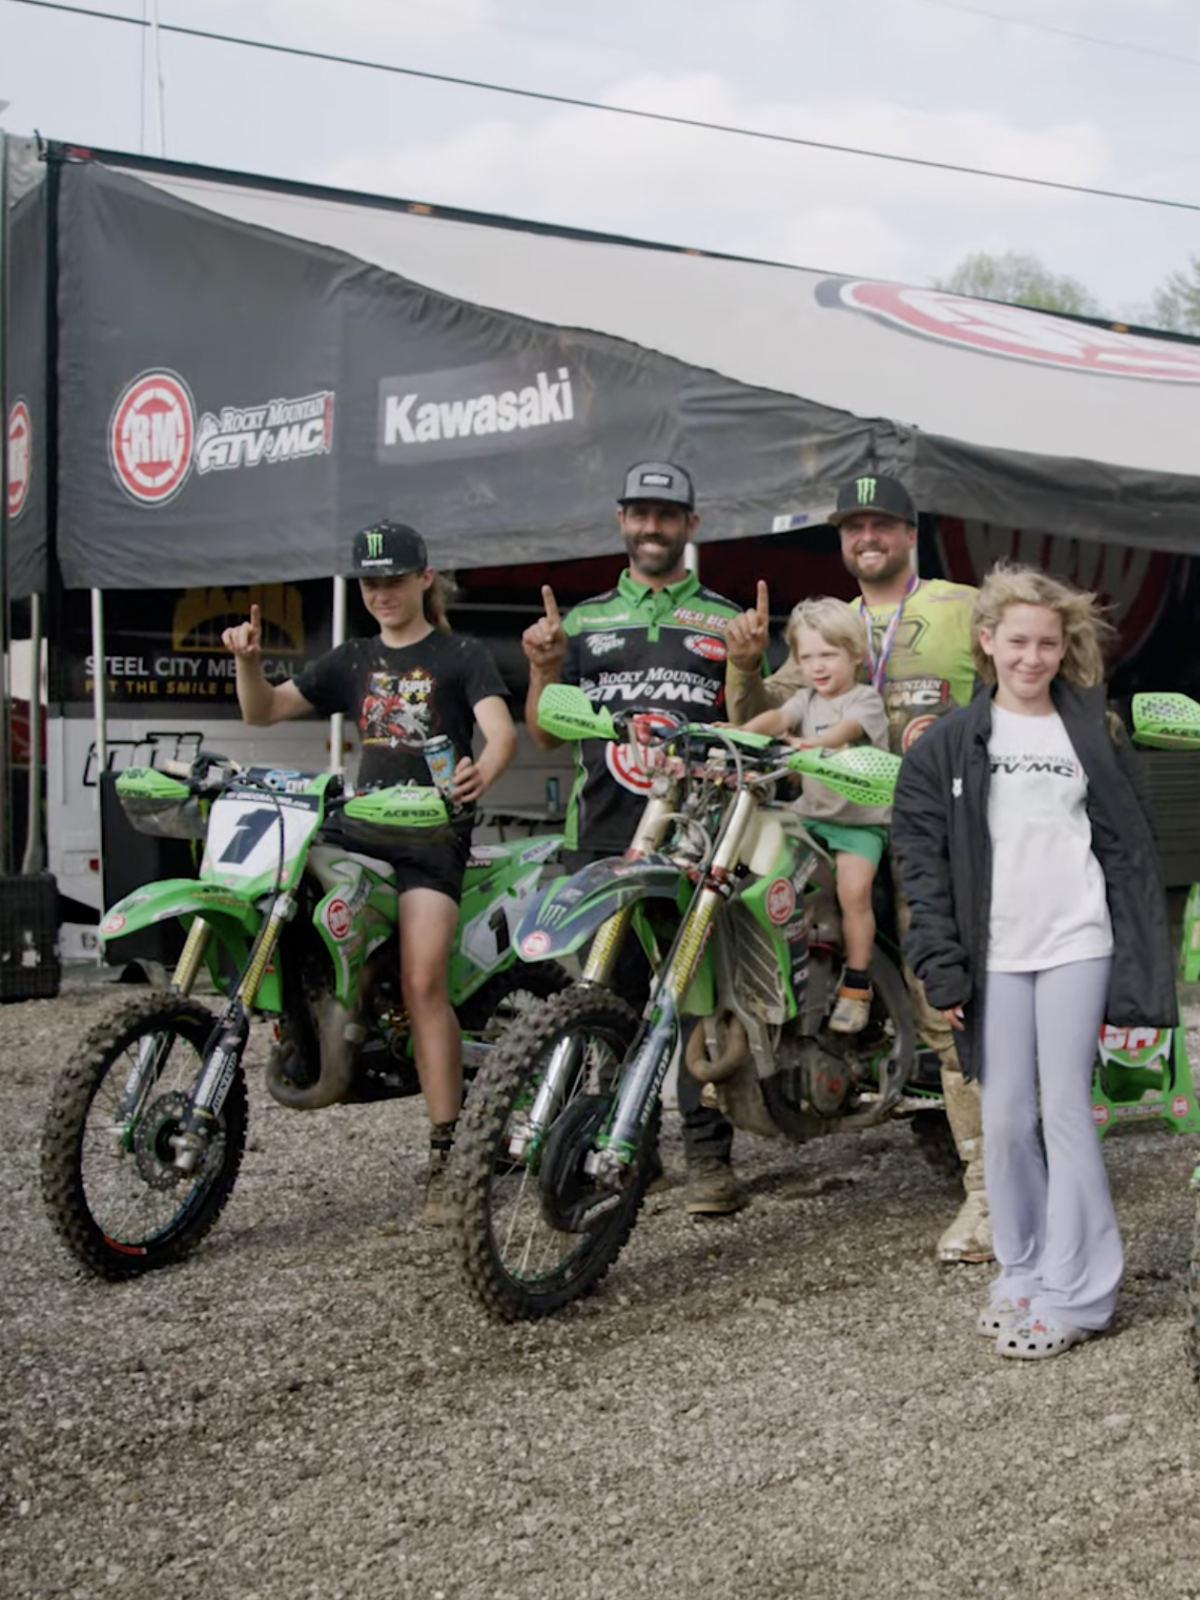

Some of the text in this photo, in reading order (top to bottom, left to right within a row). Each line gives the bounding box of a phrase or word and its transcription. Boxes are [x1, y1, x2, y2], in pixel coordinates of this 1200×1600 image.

[220, 397, 325, 433] ROCKY MOUNTAIN
[384, 367, 574, 445] Kawasaki
[155, 657, 202, 676] CITY
[208, 659, 298, 678] MECAL
[598, 666, 720, 692] ROCKY MOUNTAIN
[85, 680, 118, 693] PT
[125, 680, 158, 694] THE
[166, 681, 217, 694] SMILE
[218, 808, 281, 864] 1
[640, 1046, 670, 1126] DUNLOP
